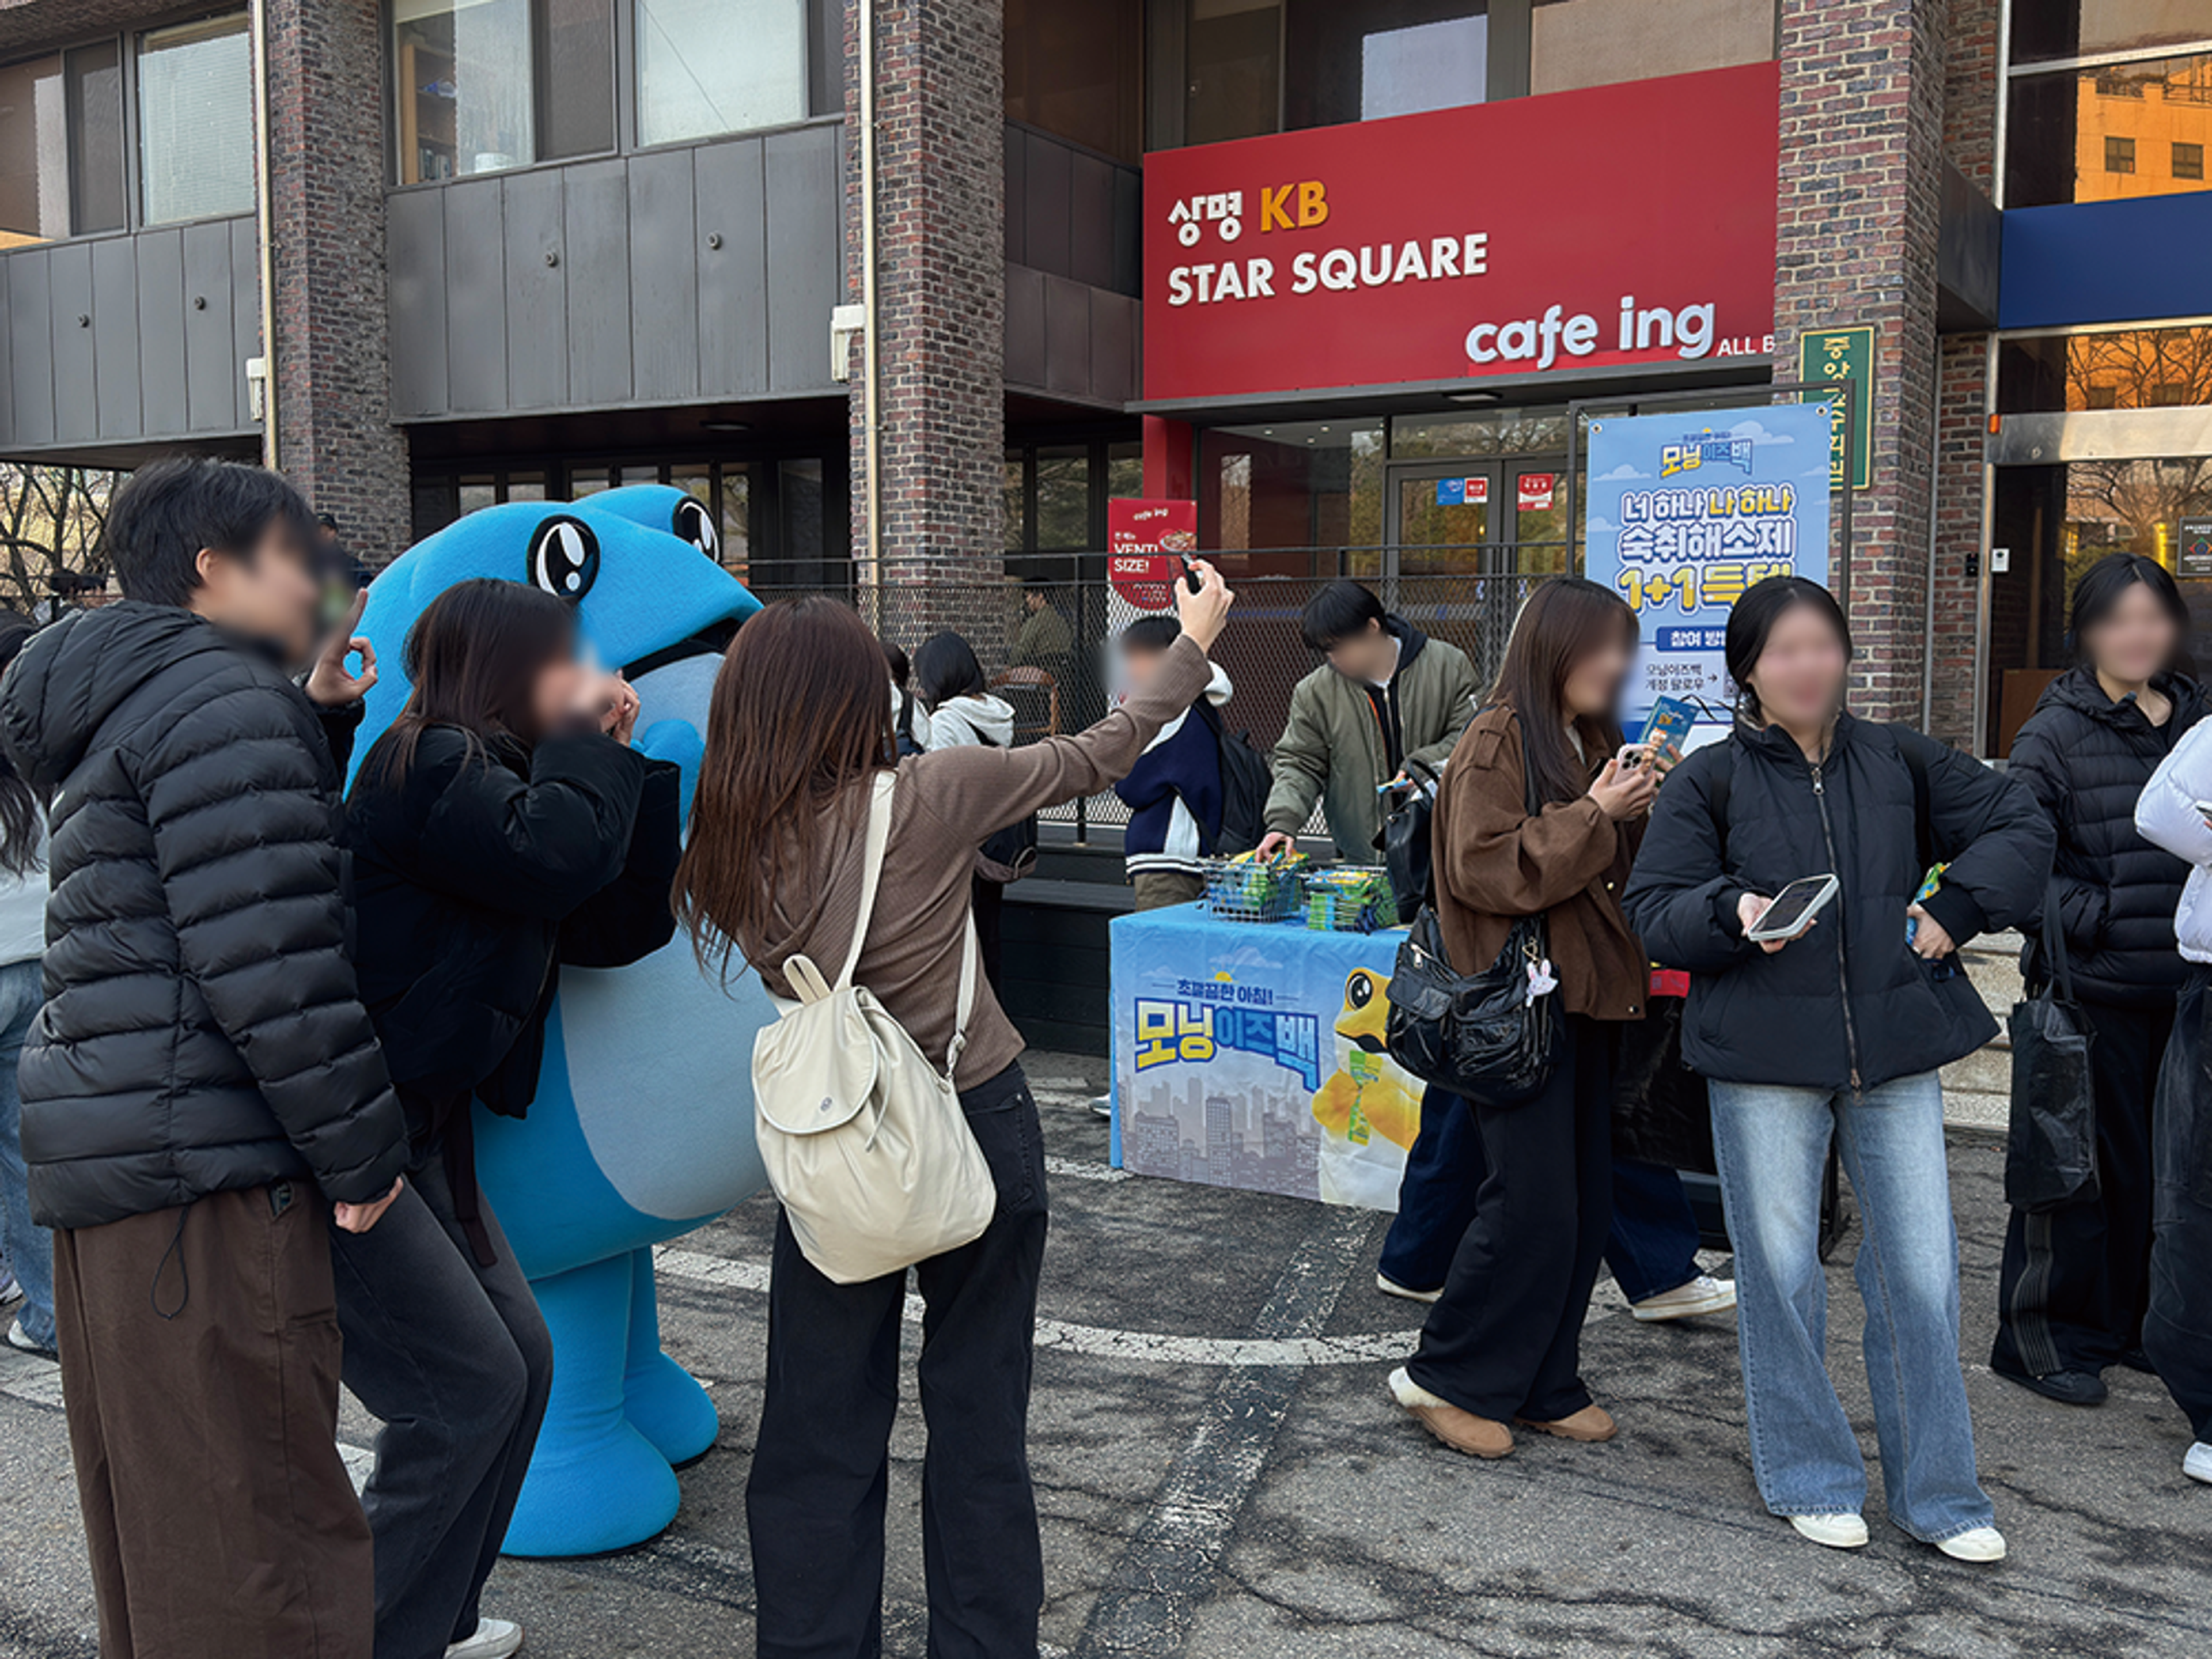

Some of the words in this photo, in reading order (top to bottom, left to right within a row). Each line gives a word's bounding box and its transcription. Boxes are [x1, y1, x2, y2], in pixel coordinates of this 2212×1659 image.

[1168, 190, 1243, 247] 상명
[1260, 180, 1329, 232] KB
[1167, 257, 1275, 306] STAR
[1291, 232, 1489, 294] SQUARE
[1465, 304, 1599, 370] cafe
[1618, 295, 1715, 359] ing
[1717, 336, 1756, 357] ALL
[1660, 438, 1752, 479] 모닝이즈백
[1624, 494, 1648, 521] 너
[1654, 490, 1705, 521] 하나
[1709, 489, 1735, 517] 나
[1739, 486, 1792, 516] 하나
[1621, 521, 1792, 562] 숙취해소제
[1114, 559, 1150, 574] SIZE!
[1671, 630, 1702, 647] 참여
[1705, 630, 1726, 646] 방
[1238, 986, 1273, 1006] 아침!
[1135, 997, 1321, 1094] 모닝이즈백
